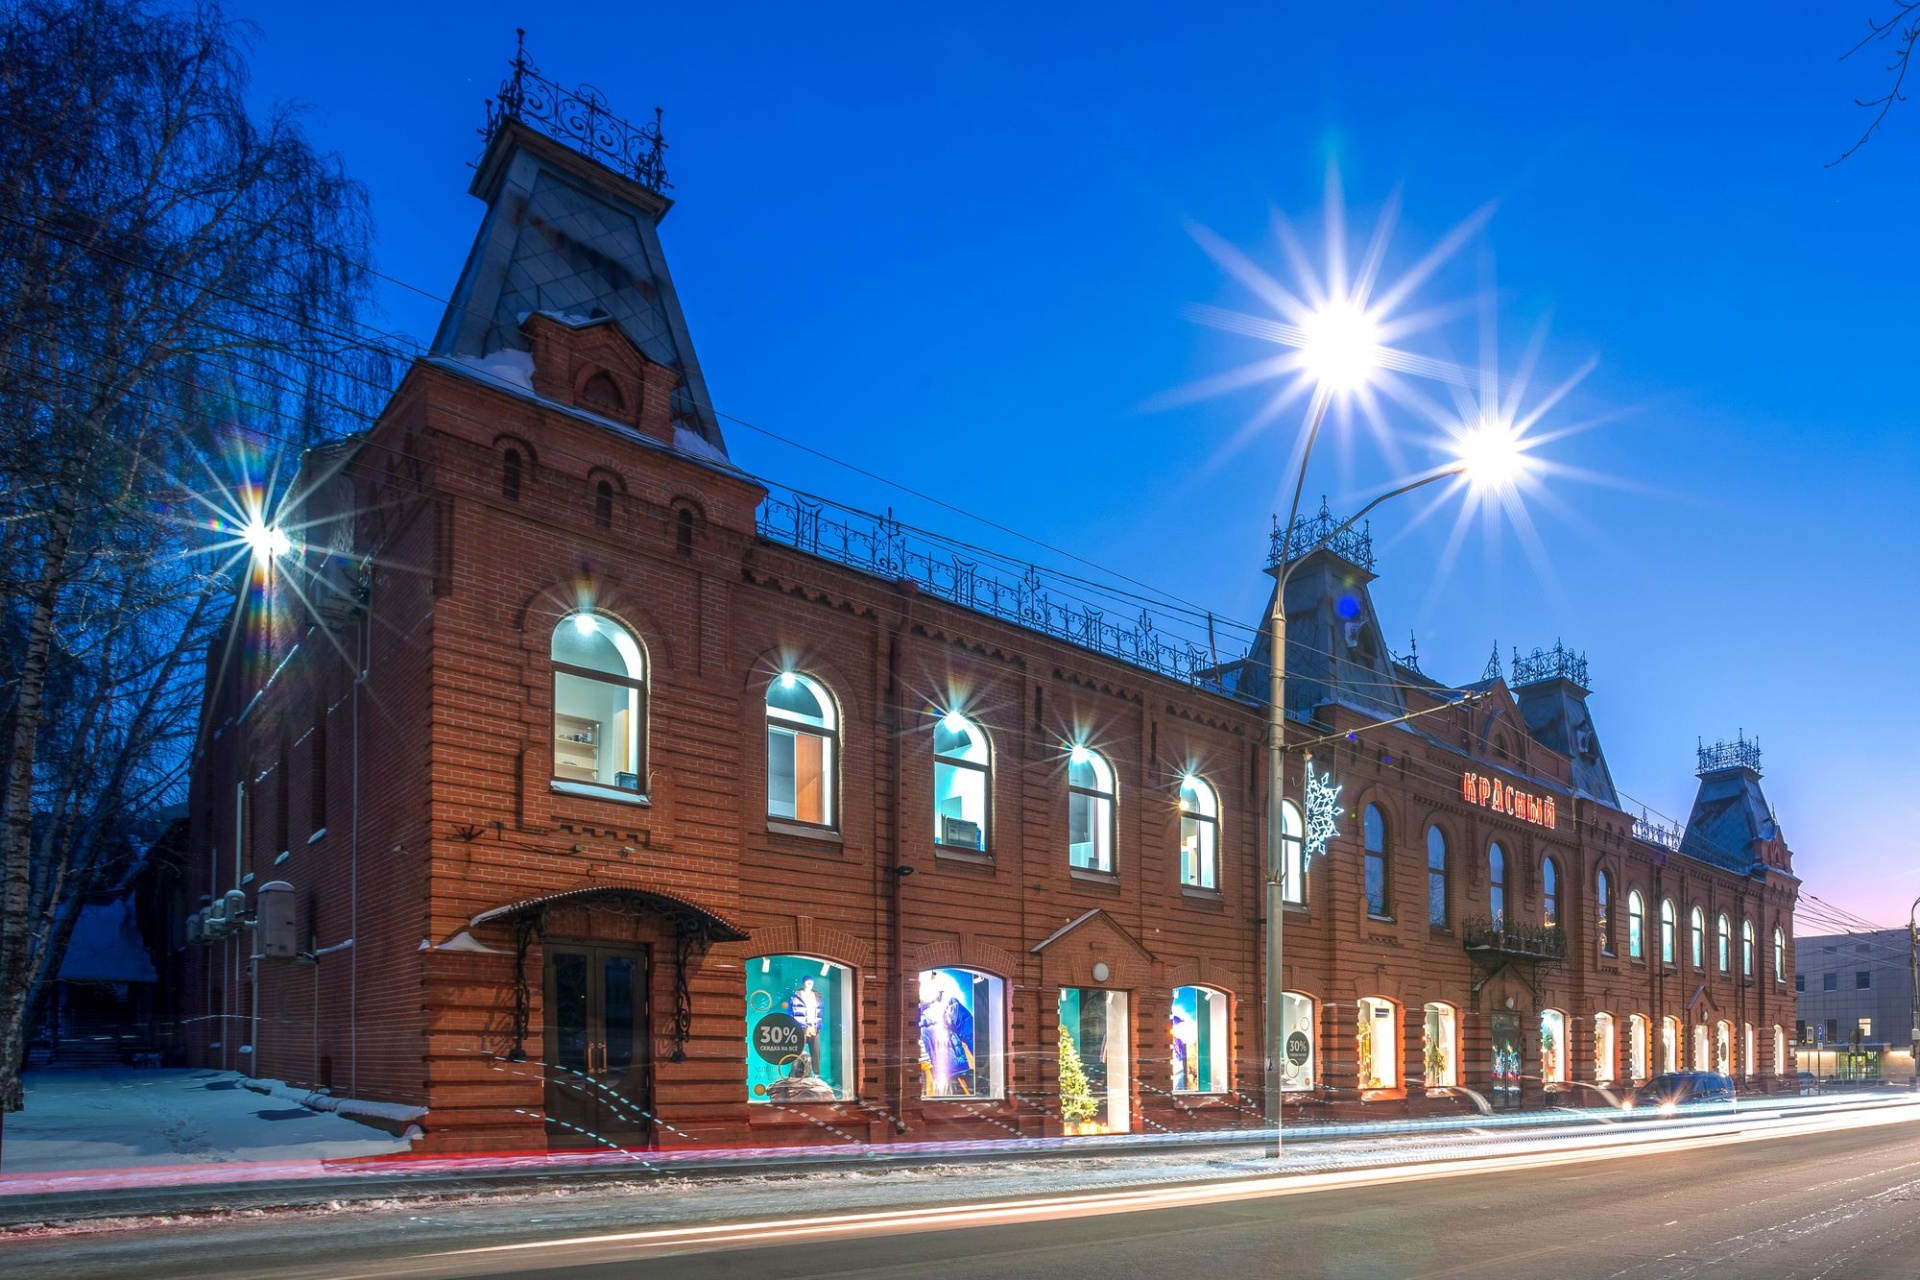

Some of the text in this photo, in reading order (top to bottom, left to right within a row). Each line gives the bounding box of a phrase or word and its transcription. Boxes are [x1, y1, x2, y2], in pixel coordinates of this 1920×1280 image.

[1464, 772, 1555, 830] КРАСНЫЙ
[760, 1026, 798, 1044] 30%
[1289, 1040, 1307, 1052] 30%
